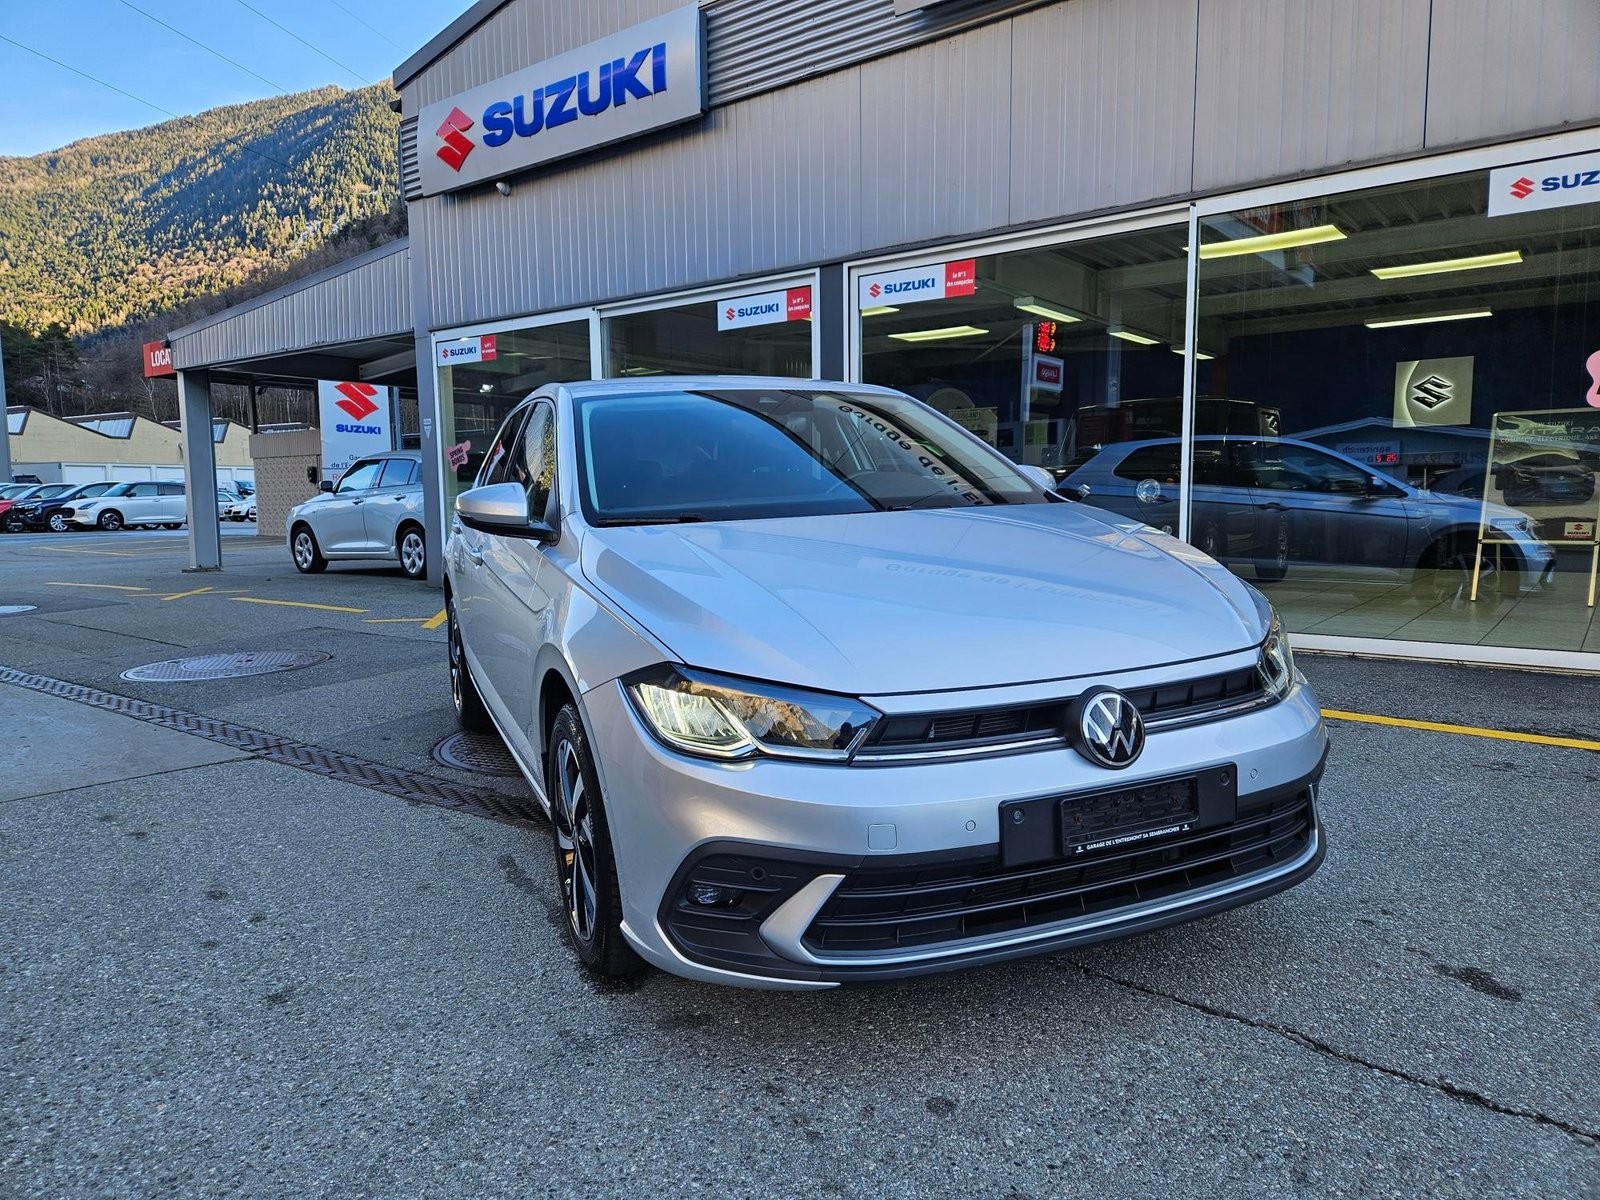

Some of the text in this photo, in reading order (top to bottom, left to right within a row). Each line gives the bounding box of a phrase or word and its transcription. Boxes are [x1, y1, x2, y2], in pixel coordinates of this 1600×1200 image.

[482, 42, 667, 147] SUZUKI
[884, 278, 935, 294] SUZUKI
[738, 303, 779, 317] SUZUKI
[151, 348, 171, 367] LOCA
[450, 346, 477, 356] SUZUKI
[336, 424, 381, 434] SUZUKI
[1087, 841, 1105, 850] GARAGE
[1113, 834, 1142, 845] L'ENTREMONT
